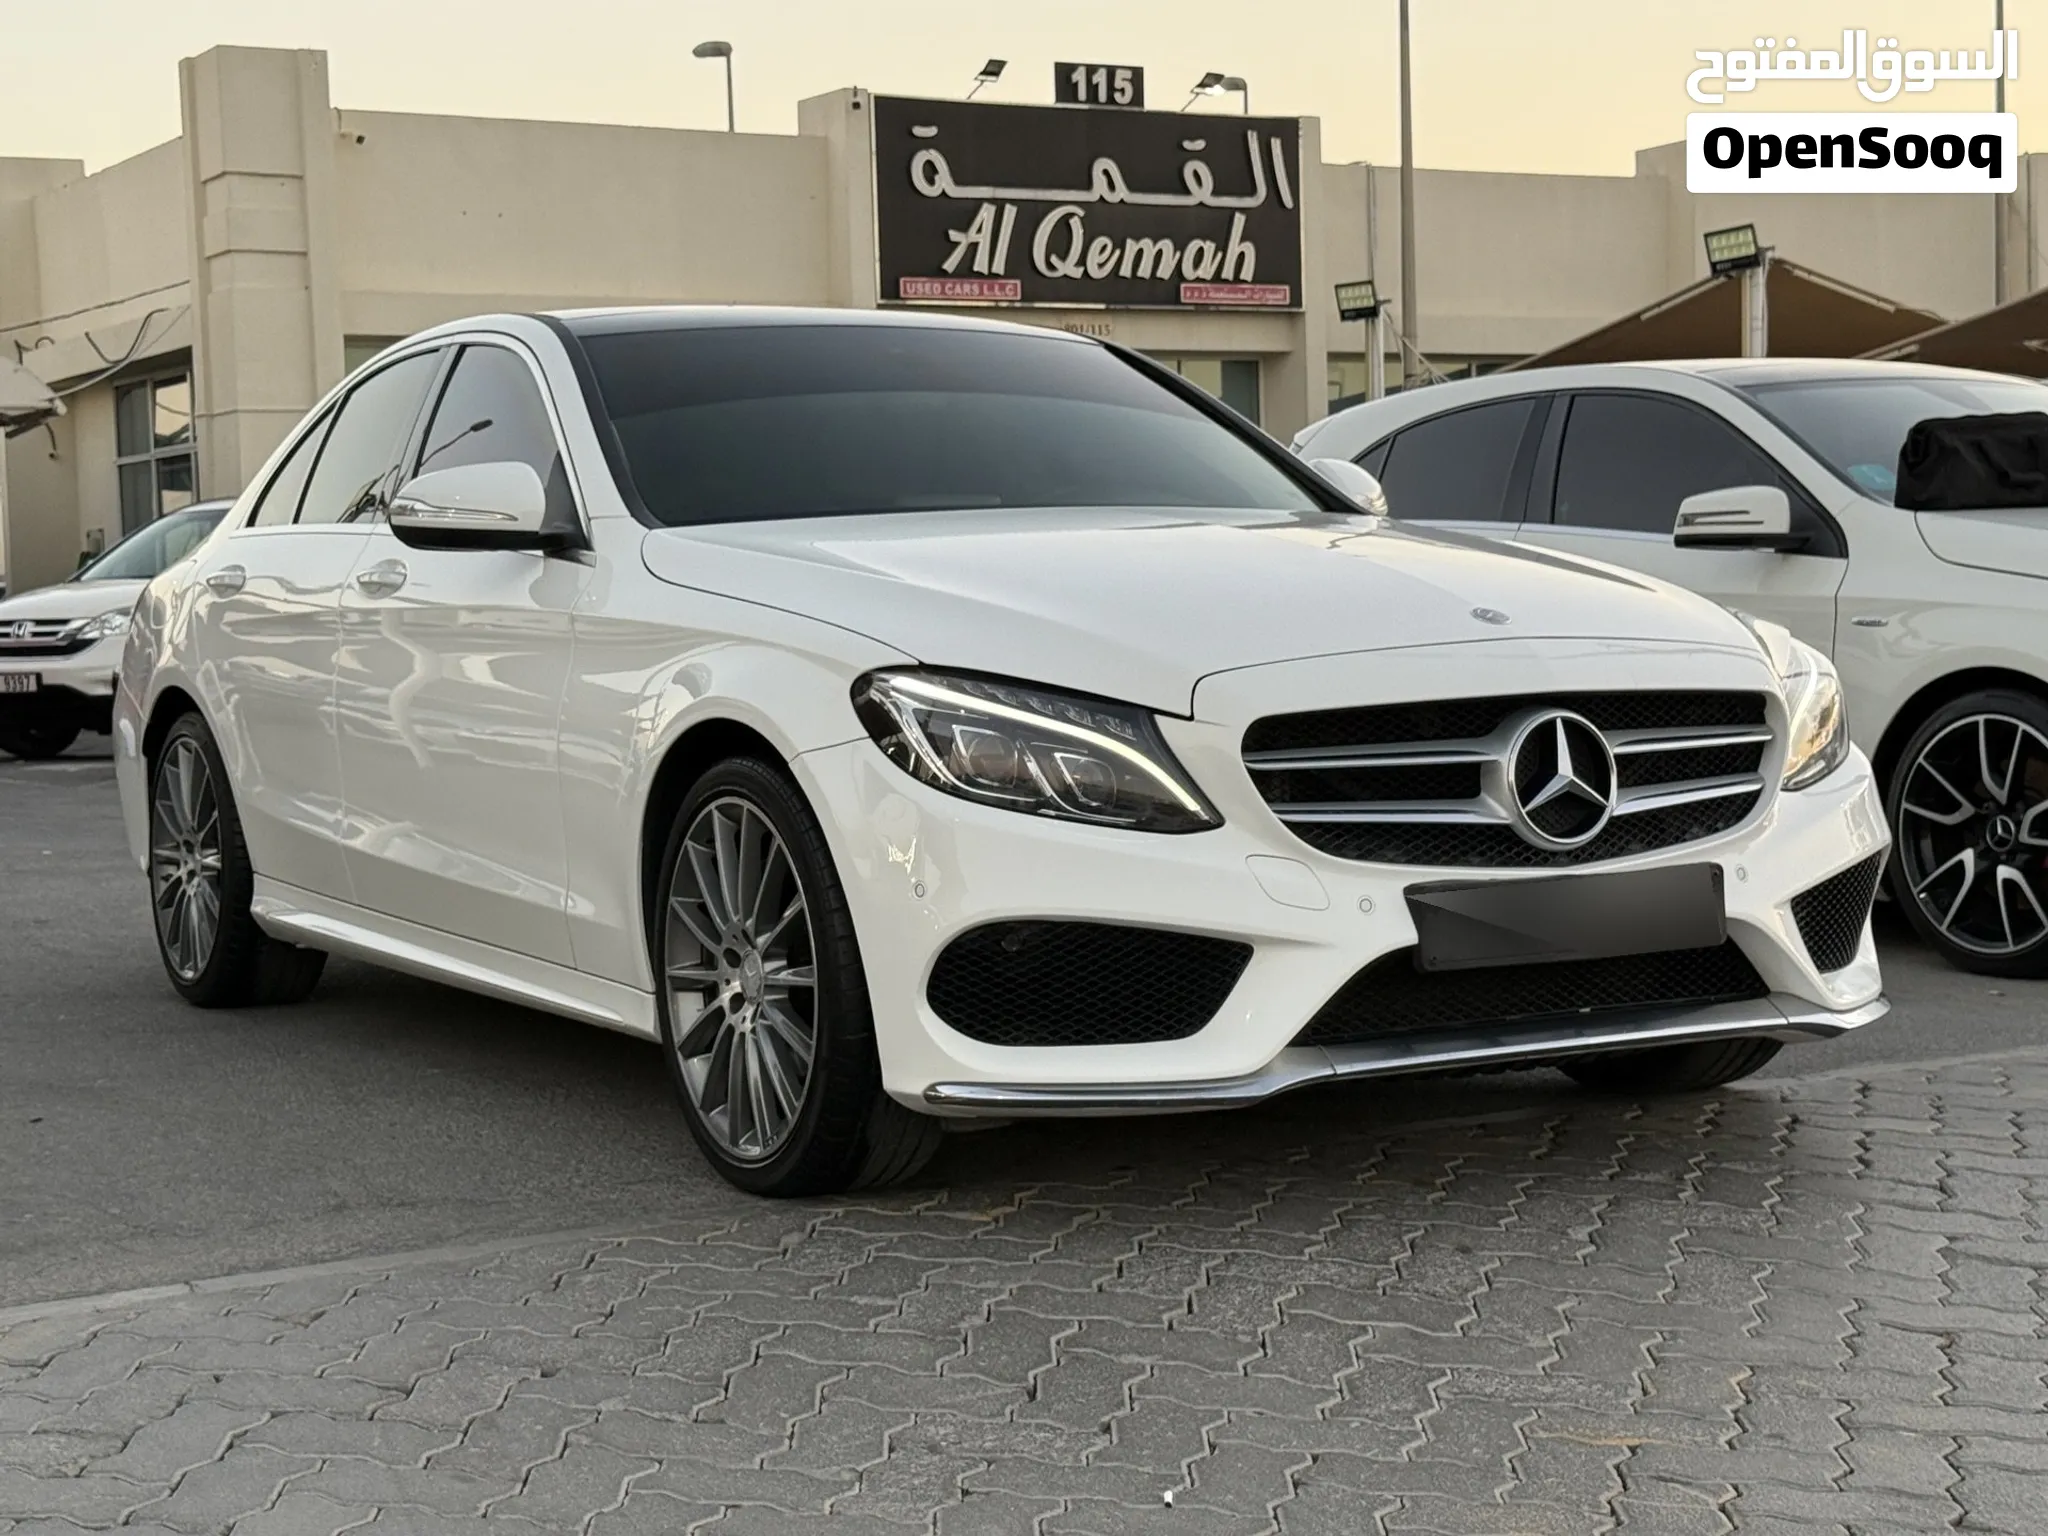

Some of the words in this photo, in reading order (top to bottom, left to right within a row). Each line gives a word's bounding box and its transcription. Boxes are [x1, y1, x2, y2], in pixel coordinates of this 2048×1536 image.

[1070, 65, 1134, 106] 115
[910, 125, 1294, 210] القمة
[941, 203, 1018, 276] Al
[1032, 204, 1257, 283] Qemah
[905, 282, 942, 296] USED
[944, 282, 980, 297] CARS
